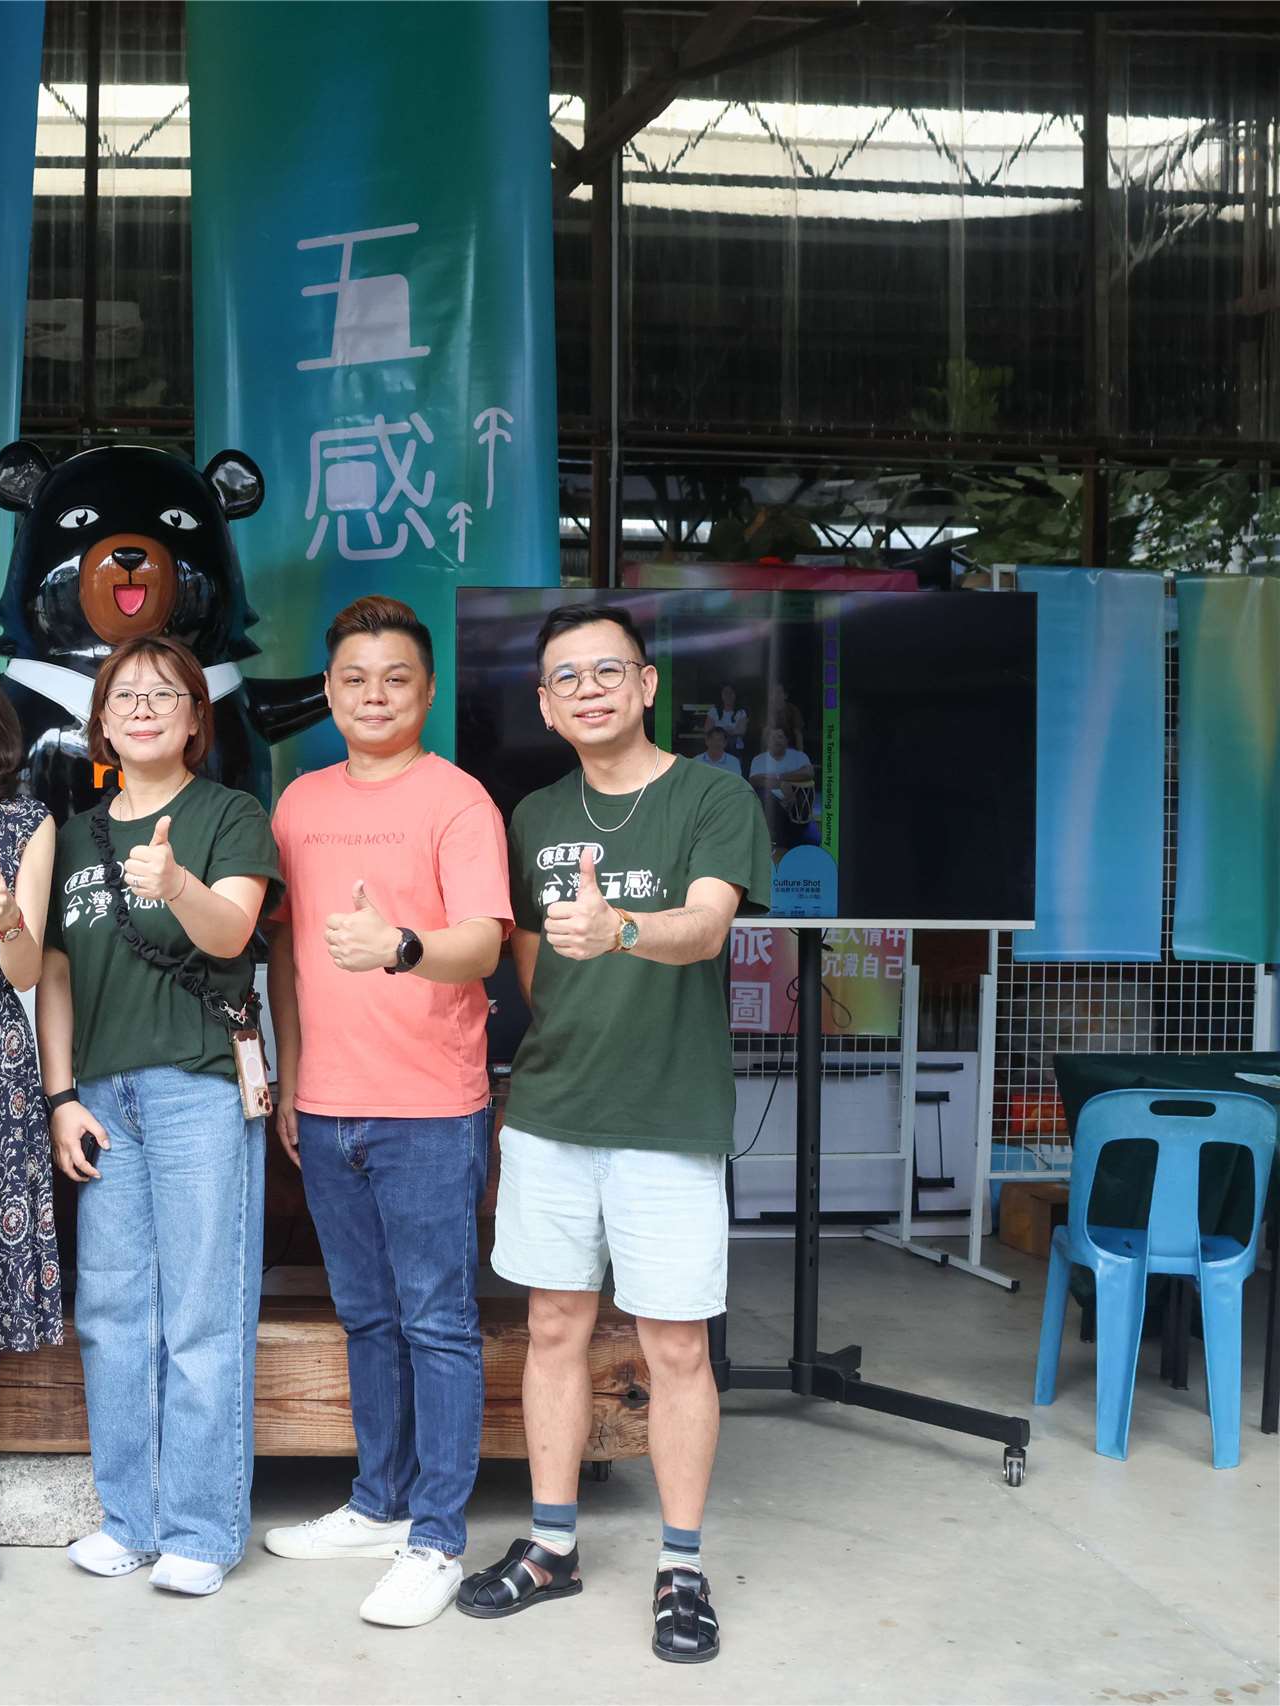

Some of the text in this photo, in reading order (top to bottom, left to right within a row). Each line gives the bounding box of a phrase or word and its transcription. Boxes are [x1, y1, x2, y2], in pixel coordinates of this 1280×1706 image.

[296, 222, 436, 562] 五感
[773, 879, 821, 887] Culture Shot
